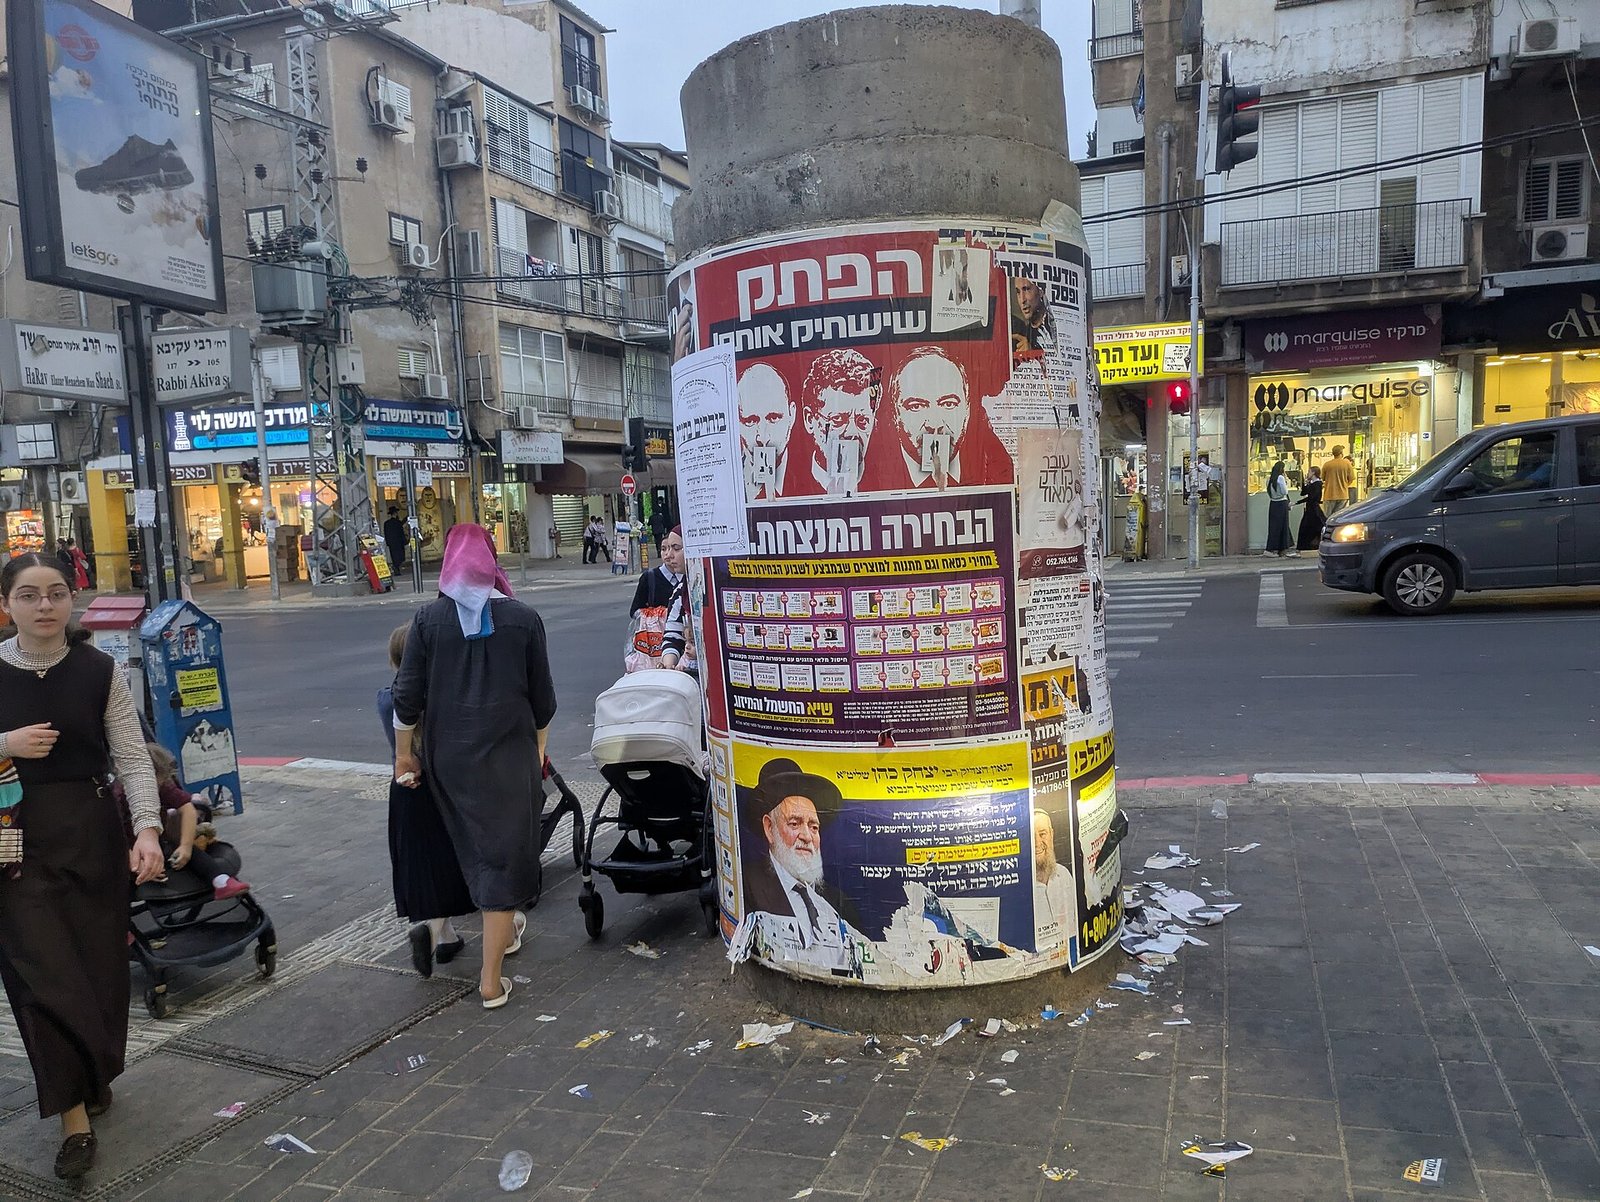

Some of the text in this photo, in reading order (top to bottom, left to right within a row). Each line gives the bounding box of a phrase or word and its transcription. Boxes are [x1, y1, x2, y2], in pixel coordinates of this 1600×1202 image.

[1043, 264, 1079, 288] הודעה
[736, 249, 924, 323] הפתק
[1051, 283, 1079, 305] ופסק
[790, 310, 927, 349] שישתיק
[1135, 330, 1147, 338] של
[1149, 328, 1175, 338] הצדקה
[1294, 327, 1380, 346] marquise
[1386, 325, 1426, 340] מרקיז
[194, 338, 212, 350] רבי
[1096, 333, 1113, 341] הדור
[156, 341, 191, 355] עקיבא
[1128, 343, 1159, 362] ועד
[1094, 347, 1124, 365] הרב
[25, 366, 48, 385] HaRav
[1102, 362, 1159, 380] לעניני צדקה
[157, 373, 221, 392] Rabbi Akiva
[1294, 378, 1429, 404] marquise
[190, 410, 211, 431] לוי
[380, 408, 412, 423] ומשה
[413, 411, 446, 426] מרדכי
[425, 460, 466, 473] מאפיית
[1042, 454, 1070, 469] עובר
[171, 465, 207, 480] מאפי
[1039, 470, 1058, 488] דק
[1043, 485, 1073, 503] מאוד
[881, 508, 995, 551] הבחירה
[853, 560, 890, 574] למוצרים
[894, 560, 923, 572] מתנות
[926, 560, 940, 571] וגם
[969, 555, 993, 567] מחירי
[753, 563, 783, 576] הבחירות
[784, 562, 810, 576] לשבוע
[811, 562, 851, 576] שבמבצע
[733, 694, 763, 710] והמיזוג
[764, 696, 805, 715] החשמל
[806, 702, 834, 716] שיא
[902, 765, 939, 783] יצחק
[942, 768, 958, 778] רבי
[960, 766, 989, 778] הצדיק
[990, 762, 1013, 772] הגאון
[871, 767, 898, 783] כהן
[886, 784, 914, 794] הנביא
[916, 782, 948, 793] שמואל
[979, 777, 994, 788] של
[1006, 815, 1017, 825] על
[860, 822, 872, 834] על
[875, 823, 911, 834] ולהשפיע
[912, 822, 937, 833] לפעול
[1007, 828, 1018, 838] כל
[901, 836, 936, 847] האפשר
[937, 834, 951, 846] בכל
[955, 834, 974, 844] אותו
[982, 842, 1018, 855] להצביע
[860, 857, 1019, 879] ואיש אינו יכול לפטור עצמו
[926, 876, 967, 892] גורלית
[970, 873, 1019, 889] במערכה
